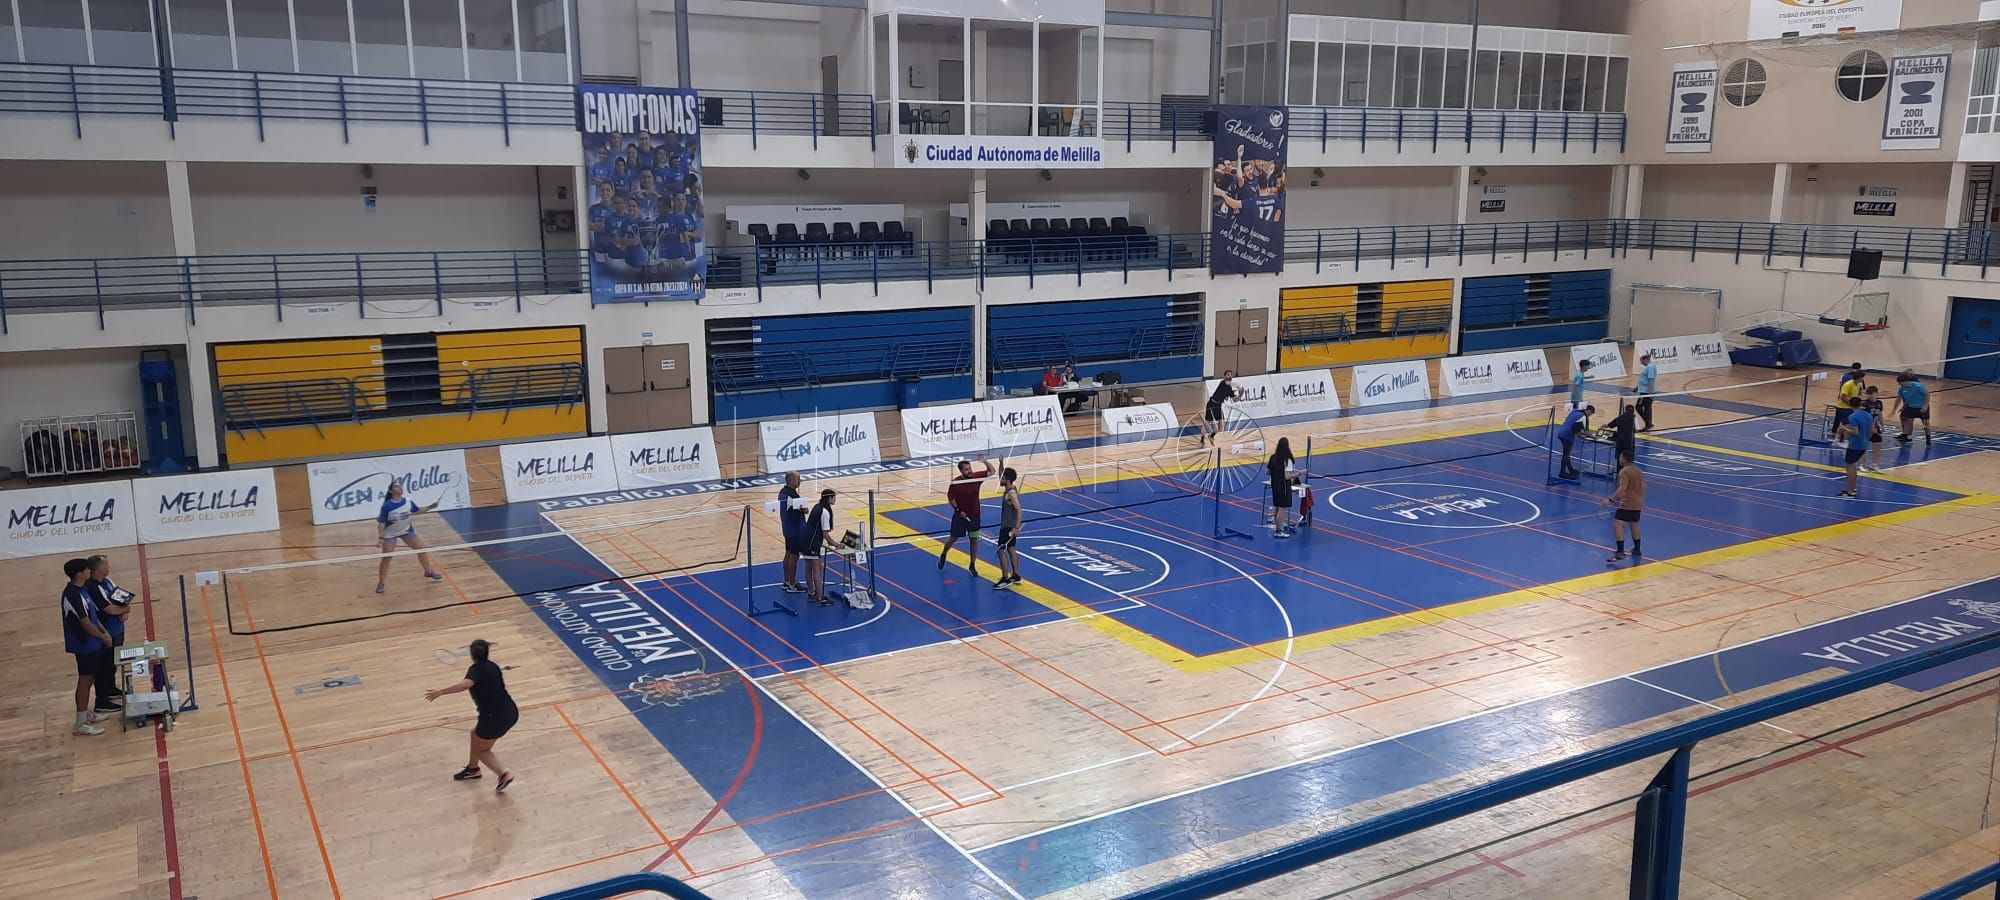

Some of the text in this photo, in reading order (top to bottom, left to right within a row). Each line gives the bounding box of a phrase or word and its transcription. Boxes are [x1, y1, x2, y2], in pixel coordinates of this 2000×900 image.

[1800, 10, 1826, 18] EUROPEA
[1838, 6, 1865, 14] DEPORTE
[1896, 66, 1944, 76] BALONCESTO
[1898, 58, 1943, 68] MELILLA
[1676, 80, 1714, 88] BALONCESTO
[1679, 72, 1713, 81] MELILLA
[583, 92, 697, 135] CAMPEONAS
[1904, 108, 1923, 118] 2001
[1680, 126, 1700, 134] COPA
[1890, 127, 1935, 136] PRINCIPE
[1900, 120, 1925, 128] COPA
[1224, 118, 1275, 150] Gladiadores
[1672, 132, 1708, 140] PRINCIPE
[926, 144, 1101, 162] Ciudad Autónoma de Melilla
[1259, 206, 1274, 220] 17
[1856, 203, 1894, 212] MELILLA
[1690, 342, 1722, 356] MELILLA
[1454, 364, 1492, 381] MELILLA
[1506, 358, 1542, 374] MELILLA
[1282, 380, 1326, 398] MELILLA
[1365, 383, 1386, 398] VEN
[1392, 369, 1420, 388] Melilla
[920, 415, 977, 436] MELILLA
[1000, 408, 1052, 428] MELILLA
[1134, 416, 1160, 424] MELILLA
[778, 442, 812, 462] VEN
[822, 424, 867, 451] Melilla
[630, 442, 700, 466] MELILLA
[516, 452, 594, 478] MELILLA
[632, 466, 656, 475] CIUDAD
[673, 462, 700, 471] DEPORTE
[328, 487, 374, 510] VEN
[394, 465, 450, 494] Melilla
[518, 472, 593, 486] CIUDAD DEL DEPORTE
[537, 454, 966, 511] Pabellón Javier mbroda Ortiz
[160, 486, 258, 514] MELILLA
[1392, 496, 1501, 520] MELILLA
[8, 498, 116, 530] MELILLA
[160, 508, 257, 524] CIUDAD DEL DEPORTE
[10, 522, 113, 540] CIUDAD DEL DEPORTE
[858, 554, 864, 562] 2
[1031, 544, 1132, 576] MELILLA
[567, 582, 697, 664] MELILLA
[1800, 616, 1984, 664] MELILLA
[581, 636, 633, 671] CIUDAD
[136, 664, 144, 674] 3
